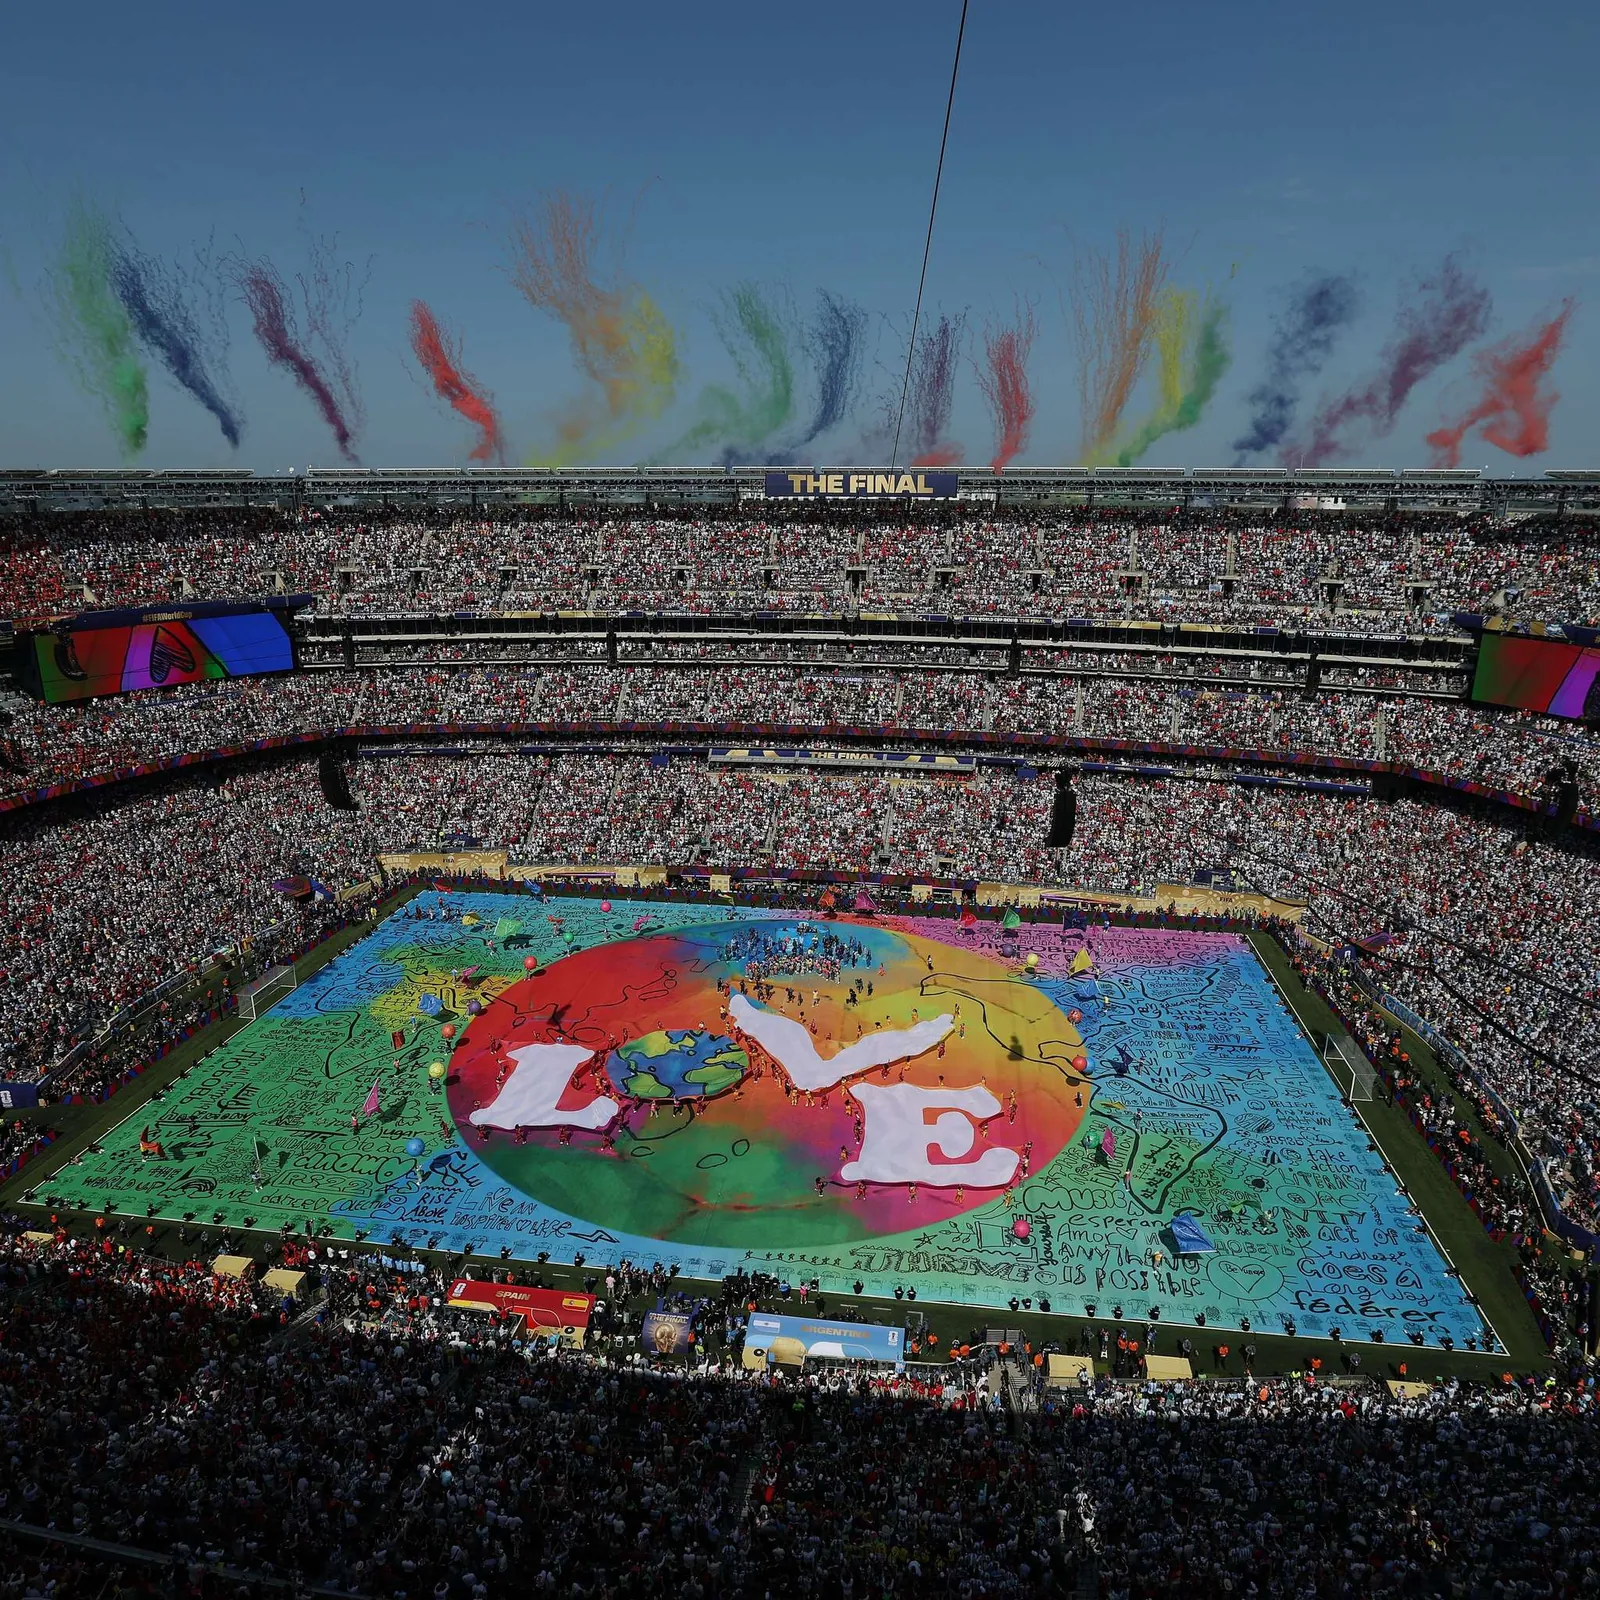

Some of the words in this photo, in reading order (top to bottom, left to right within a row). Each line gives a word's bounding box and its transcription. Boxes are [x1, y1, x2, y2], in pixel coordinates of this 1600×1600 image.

[788, 474, 844, 494] THE
[849, 474, 934, 494] FINAL
[142, 611, 193, 623] #FIFAWorldCup
[809, 751, 836, 759] THE
[837, 752, 877, 760] FINAL
[495, 1290, 532, 1301] SPAIN
[800, 1325, 871, 1338] ARGENTINA
